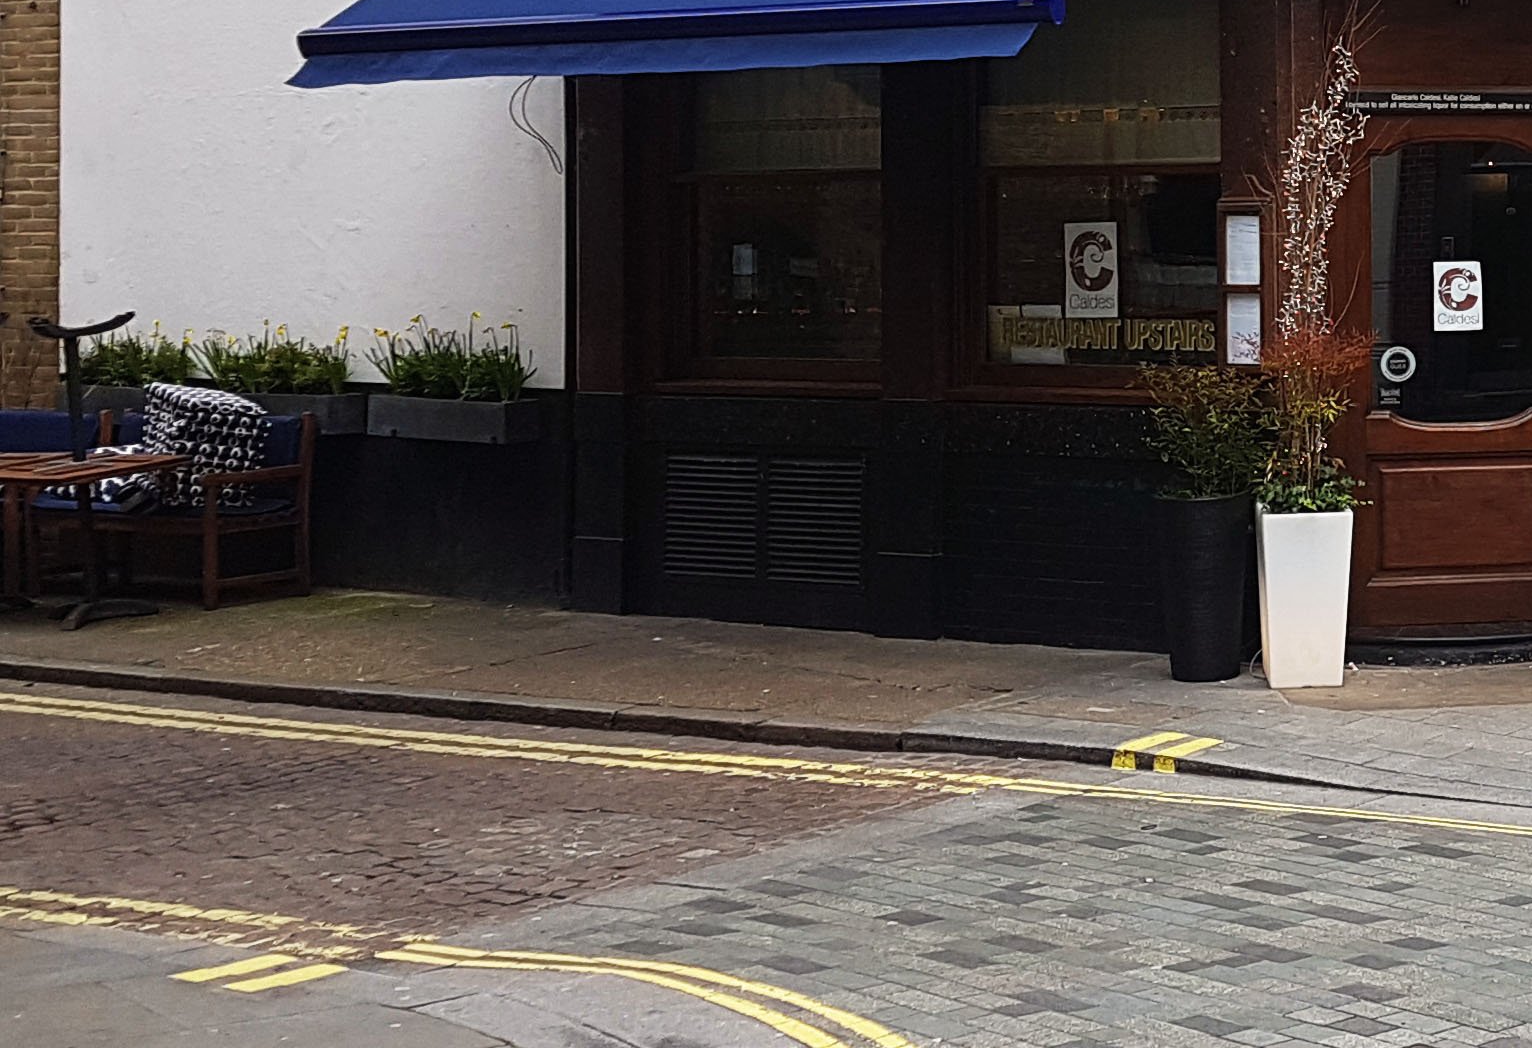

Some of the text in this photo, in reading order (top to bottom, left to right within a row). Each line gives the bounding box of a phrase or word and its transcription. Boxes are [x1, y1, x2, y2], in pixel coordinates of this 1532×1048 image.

[1069, 294, 1115, 310] Caldesi
[1438, 312, 1480, 325] Caldesi
[1002, 318, 1122, 351] RESTAURANT
[1124, 319, 1216, 352] UPSTAIRS
